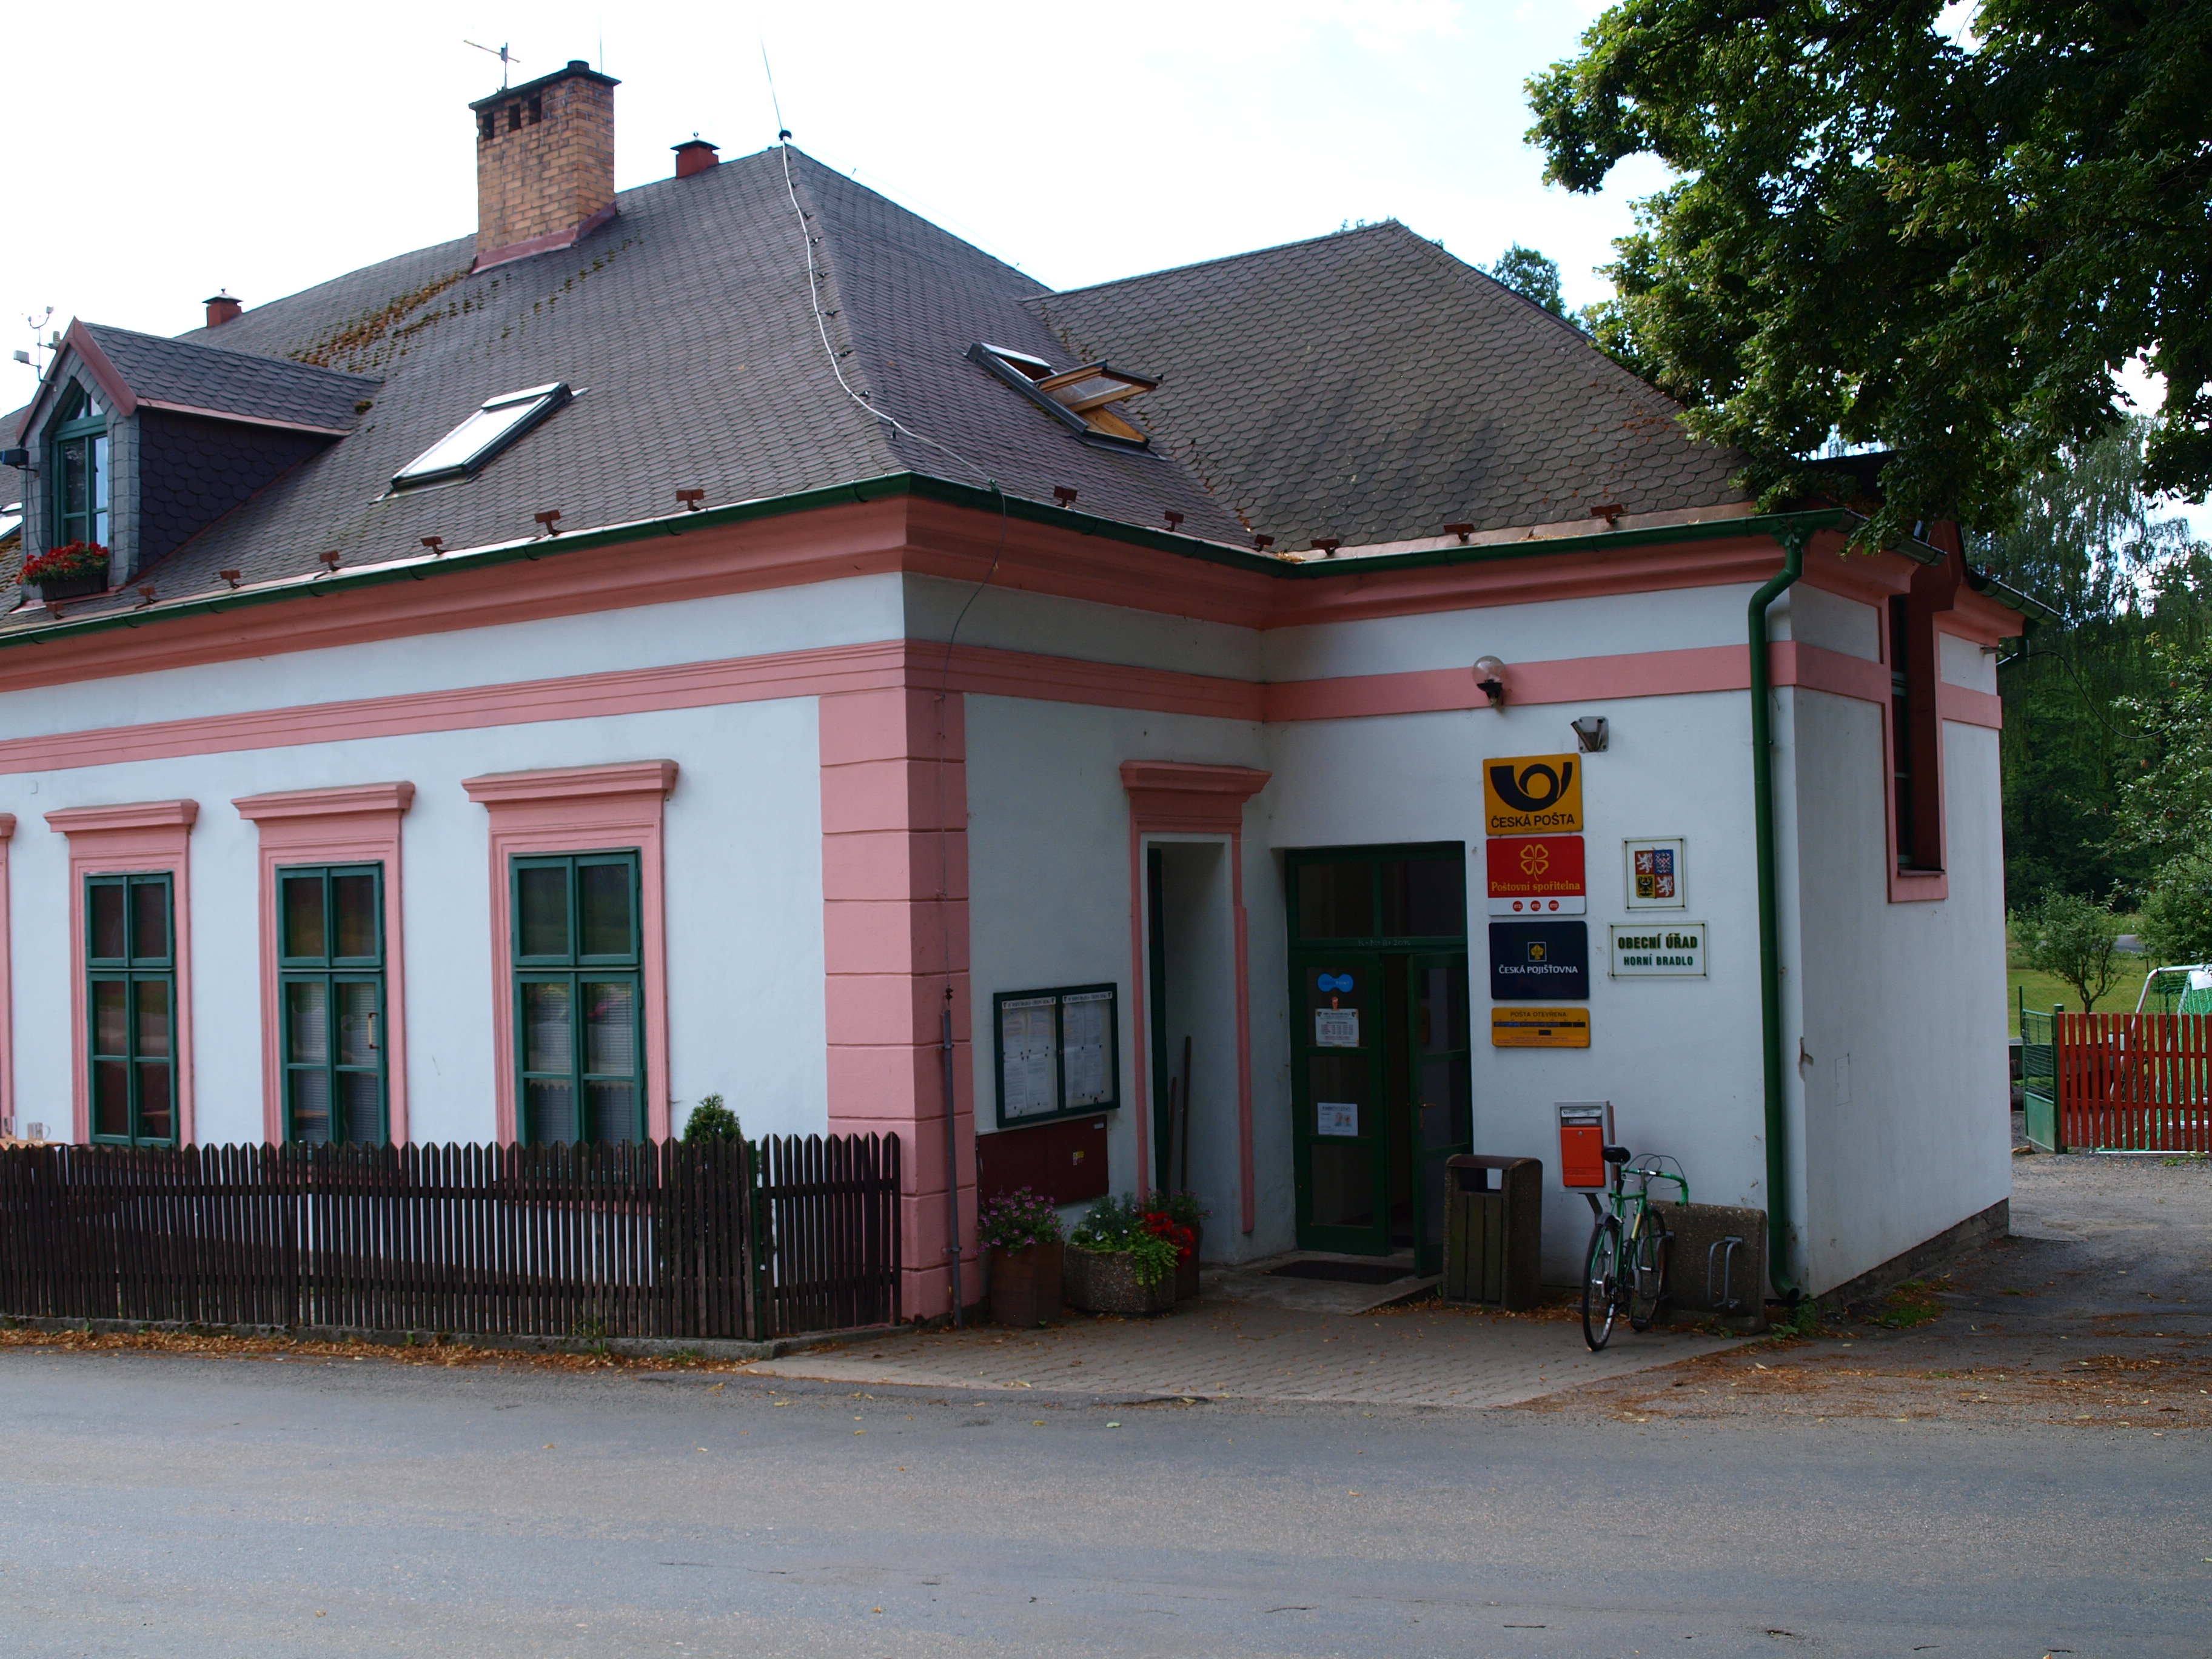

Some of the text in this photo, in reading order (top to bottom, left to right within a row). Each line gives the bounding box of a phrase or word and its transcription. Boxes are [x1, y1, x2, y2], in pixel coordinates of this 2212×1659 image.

[1491, 812, 1575, 828] ČESKÁ POŠTA
[1491, 880, 1580, 893] Poštovní spořitelna
[1618, 933, 1698, 950] OBECNÍ ÚŘAD
[1624, 953, 1693, 966] HORNÍ BRADLO
[1498, 964, 1579, 974] ČESKÁ POJIŠŤOVNA
